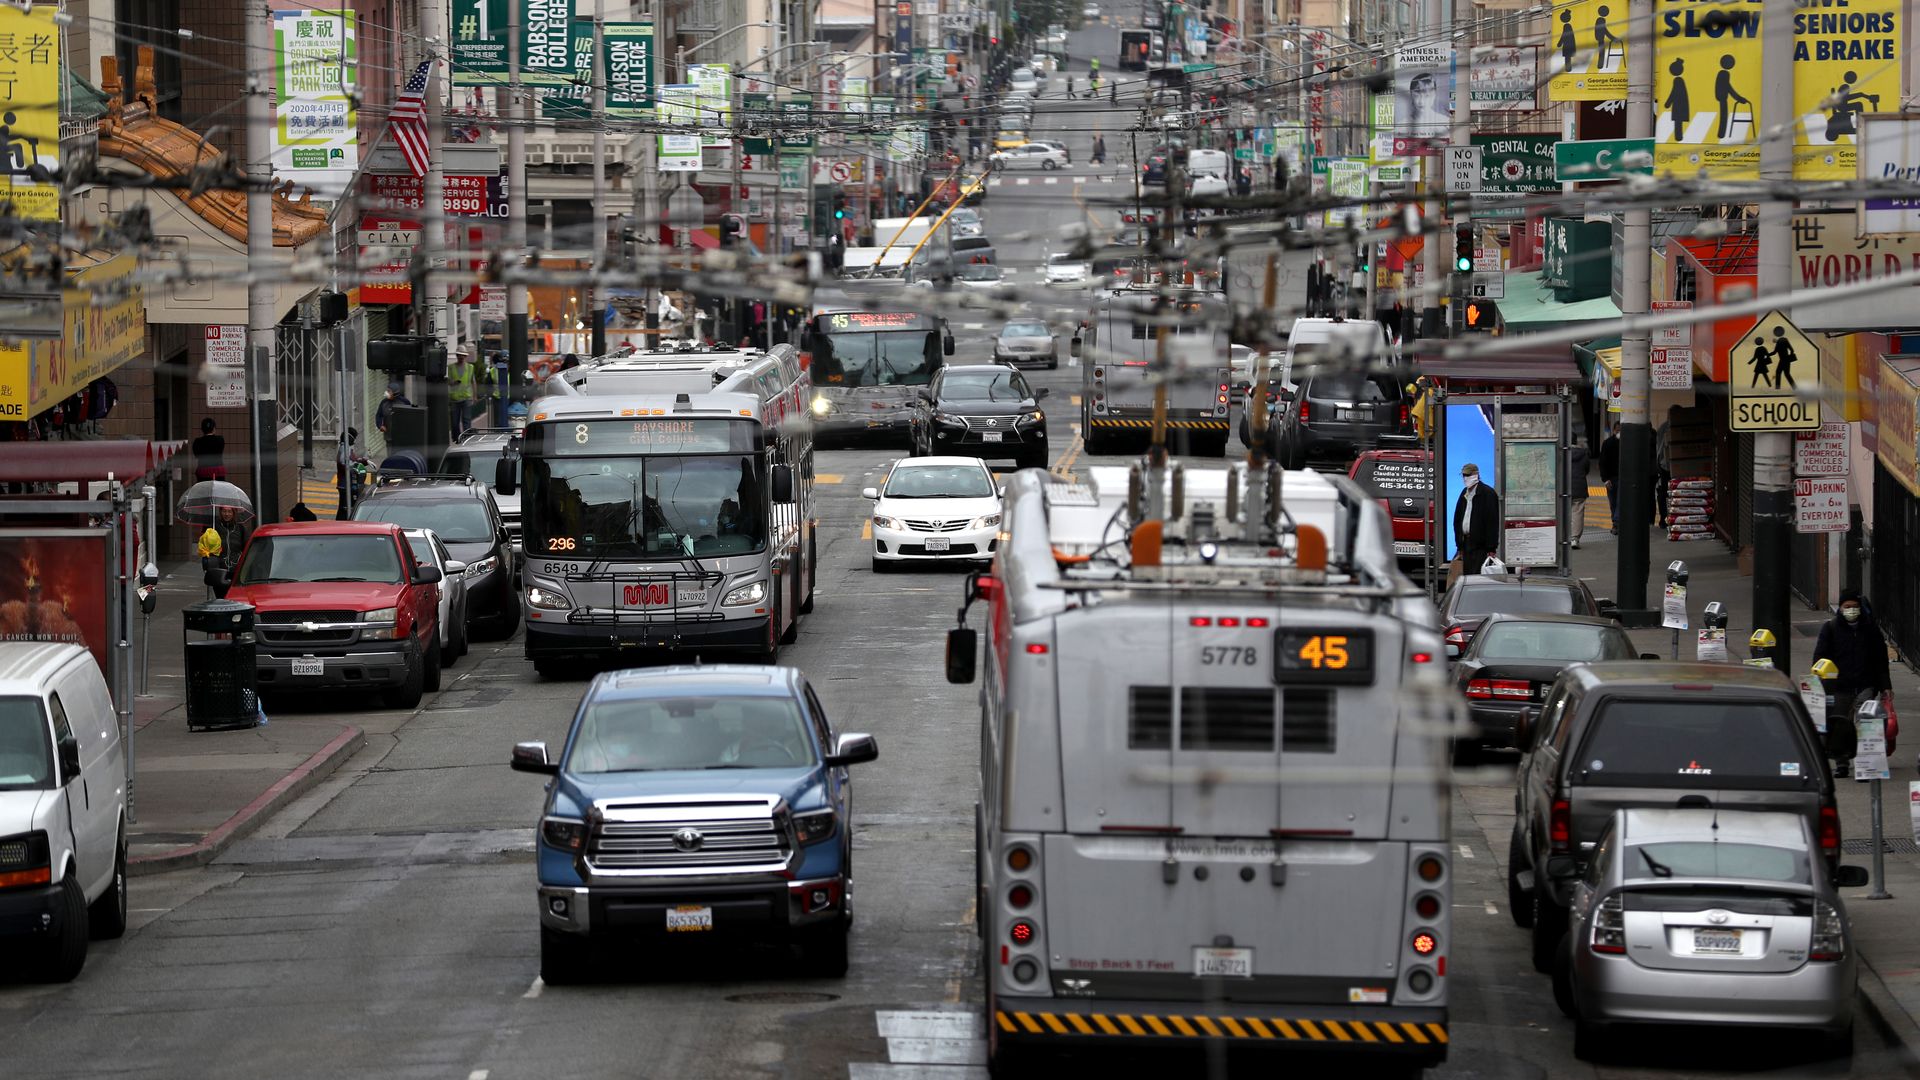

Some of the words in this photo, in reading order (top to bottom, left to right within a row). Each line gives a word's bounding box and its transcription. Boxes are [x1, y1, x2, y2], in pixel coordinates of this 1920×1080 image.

[459, 0, 488, 41] #1
[1664, 10, 1762, 38] SLOW
[1794, 12, 1894, 34] SENIORS
[296, 20, 334, 38] 慶祝
[528, 0, 548, 67] BABSON
[548, 0, 568, 68] COLLEGE
[1794, 41, 1810, 61] A
[1816, 39, 1894, 60] BRAKE
[291, 60, 320, 76] GATE
[610, 42, 630, 102] BABSON
[629, 42, 647, 102] COLLEGE
[322, 68, 342, 83] 150
[292, 76, 320, 92] PARK
[291, 115, 344, 128] 免費活動
[1492, 140, 1529, 153] DENTAL
[1454, 150, 1472, 159] NO
[1704, 150, 1732, 158] George
[0, 189, 26, 197] George
[28, 189, 54, 197] Gascón
[377, 189, 417, 197] LINGLING
[442, 190, 480, 198] SERVICE
[368, 233, 411, 243] CLAY
[832, 314, 848, 327] 45
[208, 327, 218, 338] NO
[1653, 351, 1664, 362] NO
[1738, 402, 1813, 422] SCHOOL
[575, 423, 588, 444] 8
[1796, 480, 1810, 494] NO
[1813, 483, 1845, 493] PARKING
[1801, 512, 1843, 520] EVERYDAY
[549, 537, 576, 550] 296
[544, 563, 579, 574] 6549
[1202, 646, 1258, 666] 5778
[1300, 636, 1348, 669] 45
[1069, 959, 1097, 970] Stop
[1102, 959, 1132, 969] Back
[1148, 960, 1174, 970] Feet
